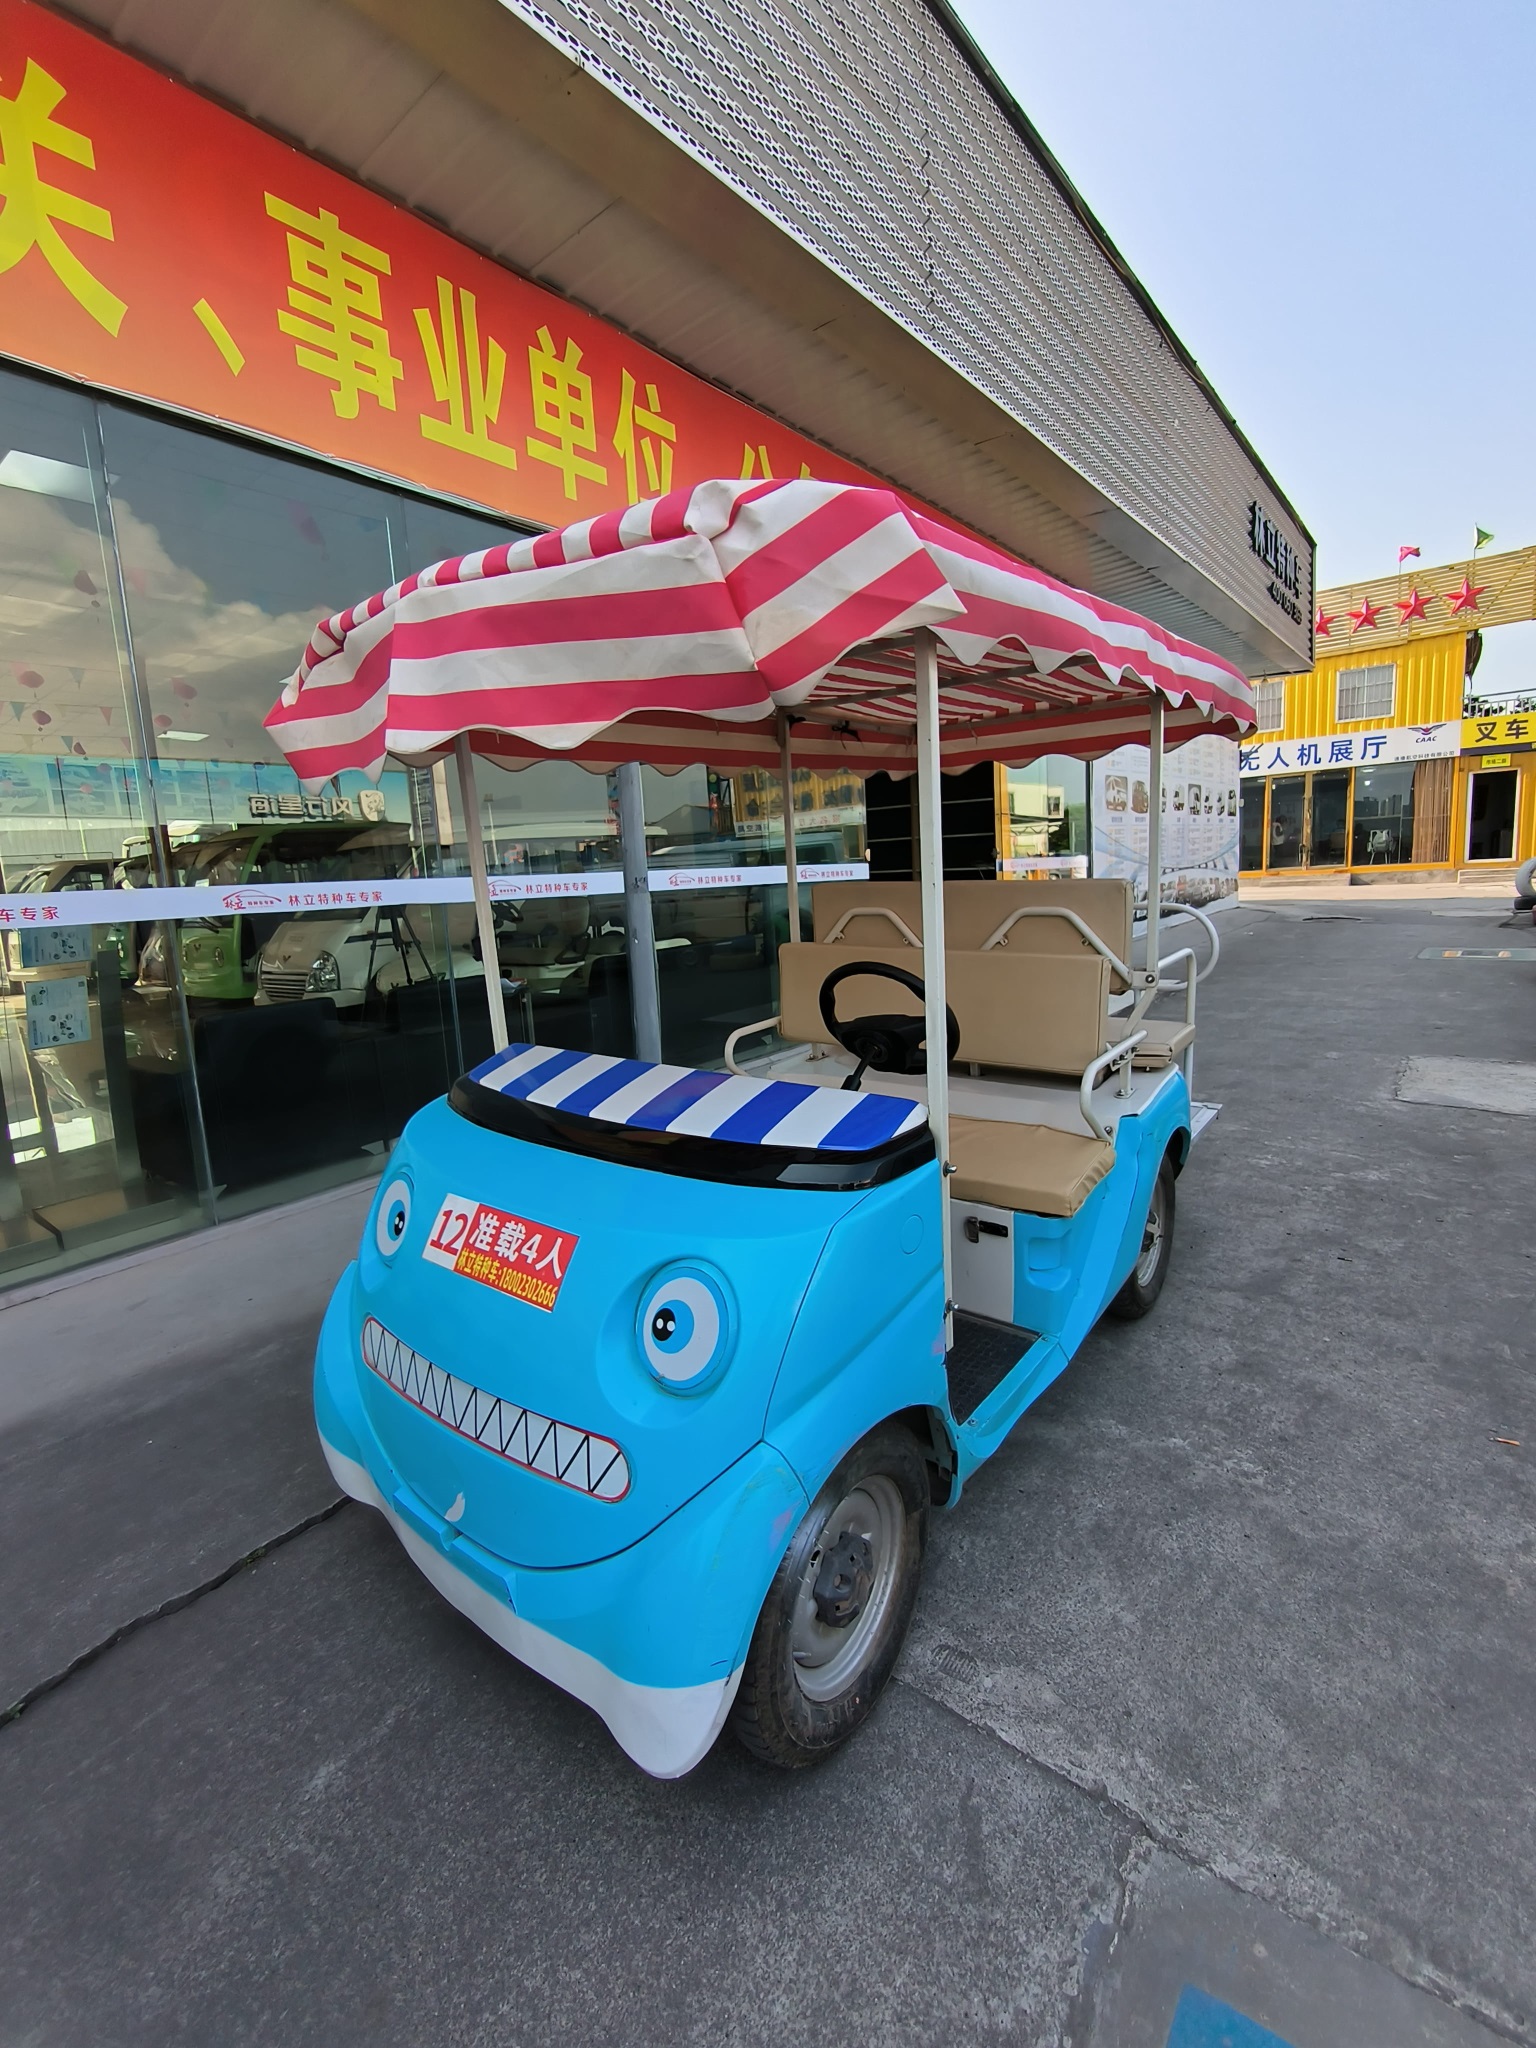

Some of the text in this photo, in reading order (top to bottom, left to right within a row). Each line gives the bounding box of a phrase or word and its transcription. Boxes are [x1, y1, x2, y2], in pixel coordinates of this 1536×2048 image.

[1475, 718, 1529, 743] 叉车
[1240, 735, 1388, 771] 无人机展厅
[288, 890, 383, 907] 林立特种车专家
[525, 882, 588, 894] 林立特种车专家
[0, 906, 60, 922] 车专家
[429, 1210, 563, 1280] 12 准载4人
